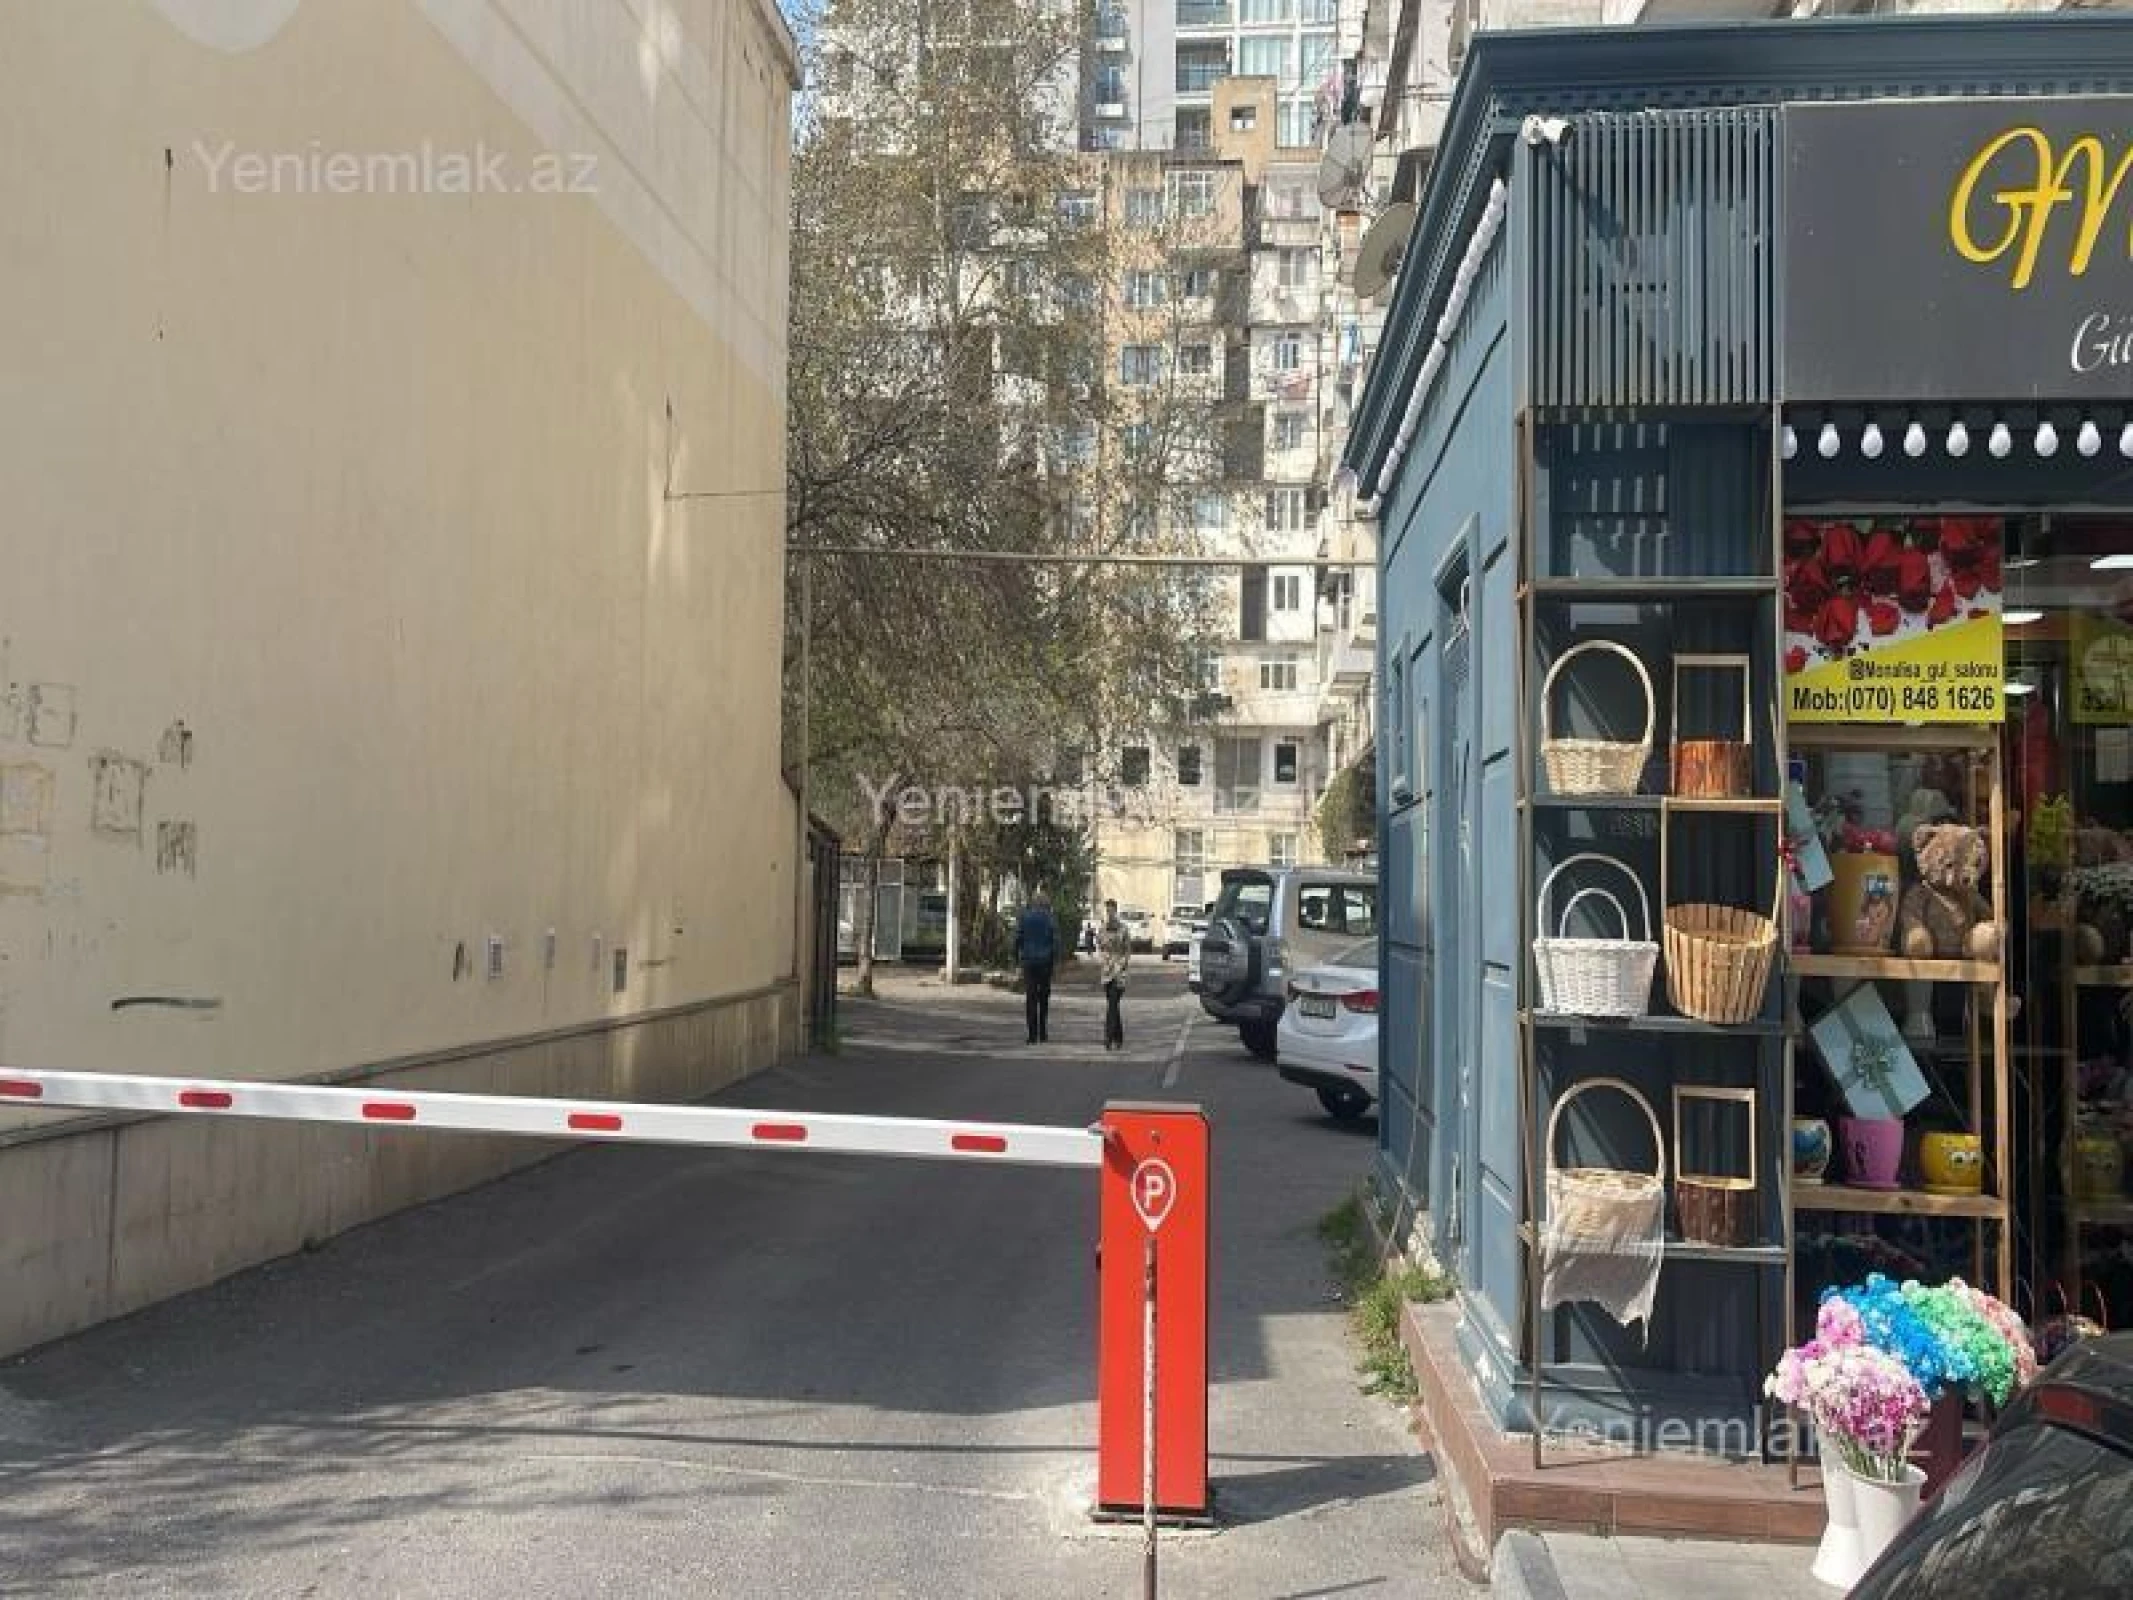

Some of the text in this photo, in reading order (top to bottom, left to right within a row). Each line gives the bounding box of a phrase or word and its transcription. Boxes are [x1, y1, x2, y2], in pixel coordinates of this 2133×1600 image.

[1793, 686, 1996, 715] Mob:(070) 848 1626
[1144, 1175, 1166, 1209] P
